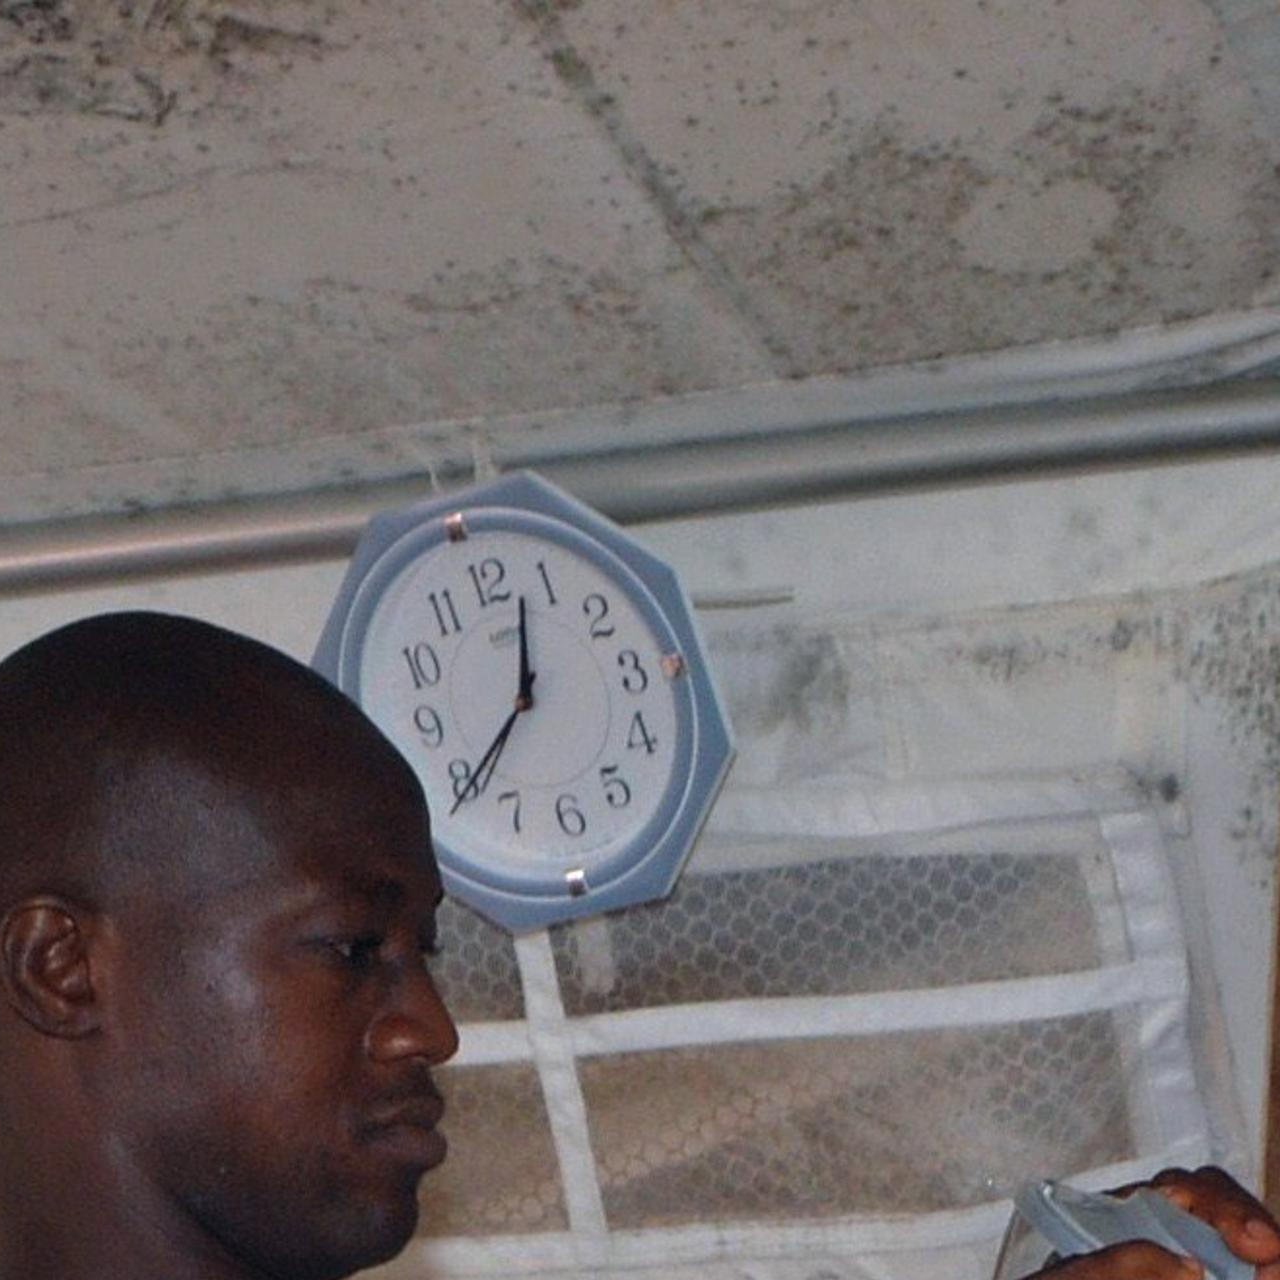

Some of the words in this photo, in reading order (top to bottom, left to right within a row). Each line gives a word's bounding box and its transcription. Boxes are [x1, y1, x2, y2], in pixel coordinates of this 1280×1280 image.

[468, 557, 512, 607] 12
[536, 561, 558, 606] 1
[429, 589, 461, 636] 11
[583, 593, 615, 638] 2
[402, 642, 441, 690] 10
[618, 650, 649, 693] 3
[413, 706, 444, 747] 9
[626, 711, 658, 755] 4
[448, 759, 480, 801] 8
[599, 765, 632, 808] 5
[498, 791, 522, 833] 7
[555, 795, 586, 837] 6
